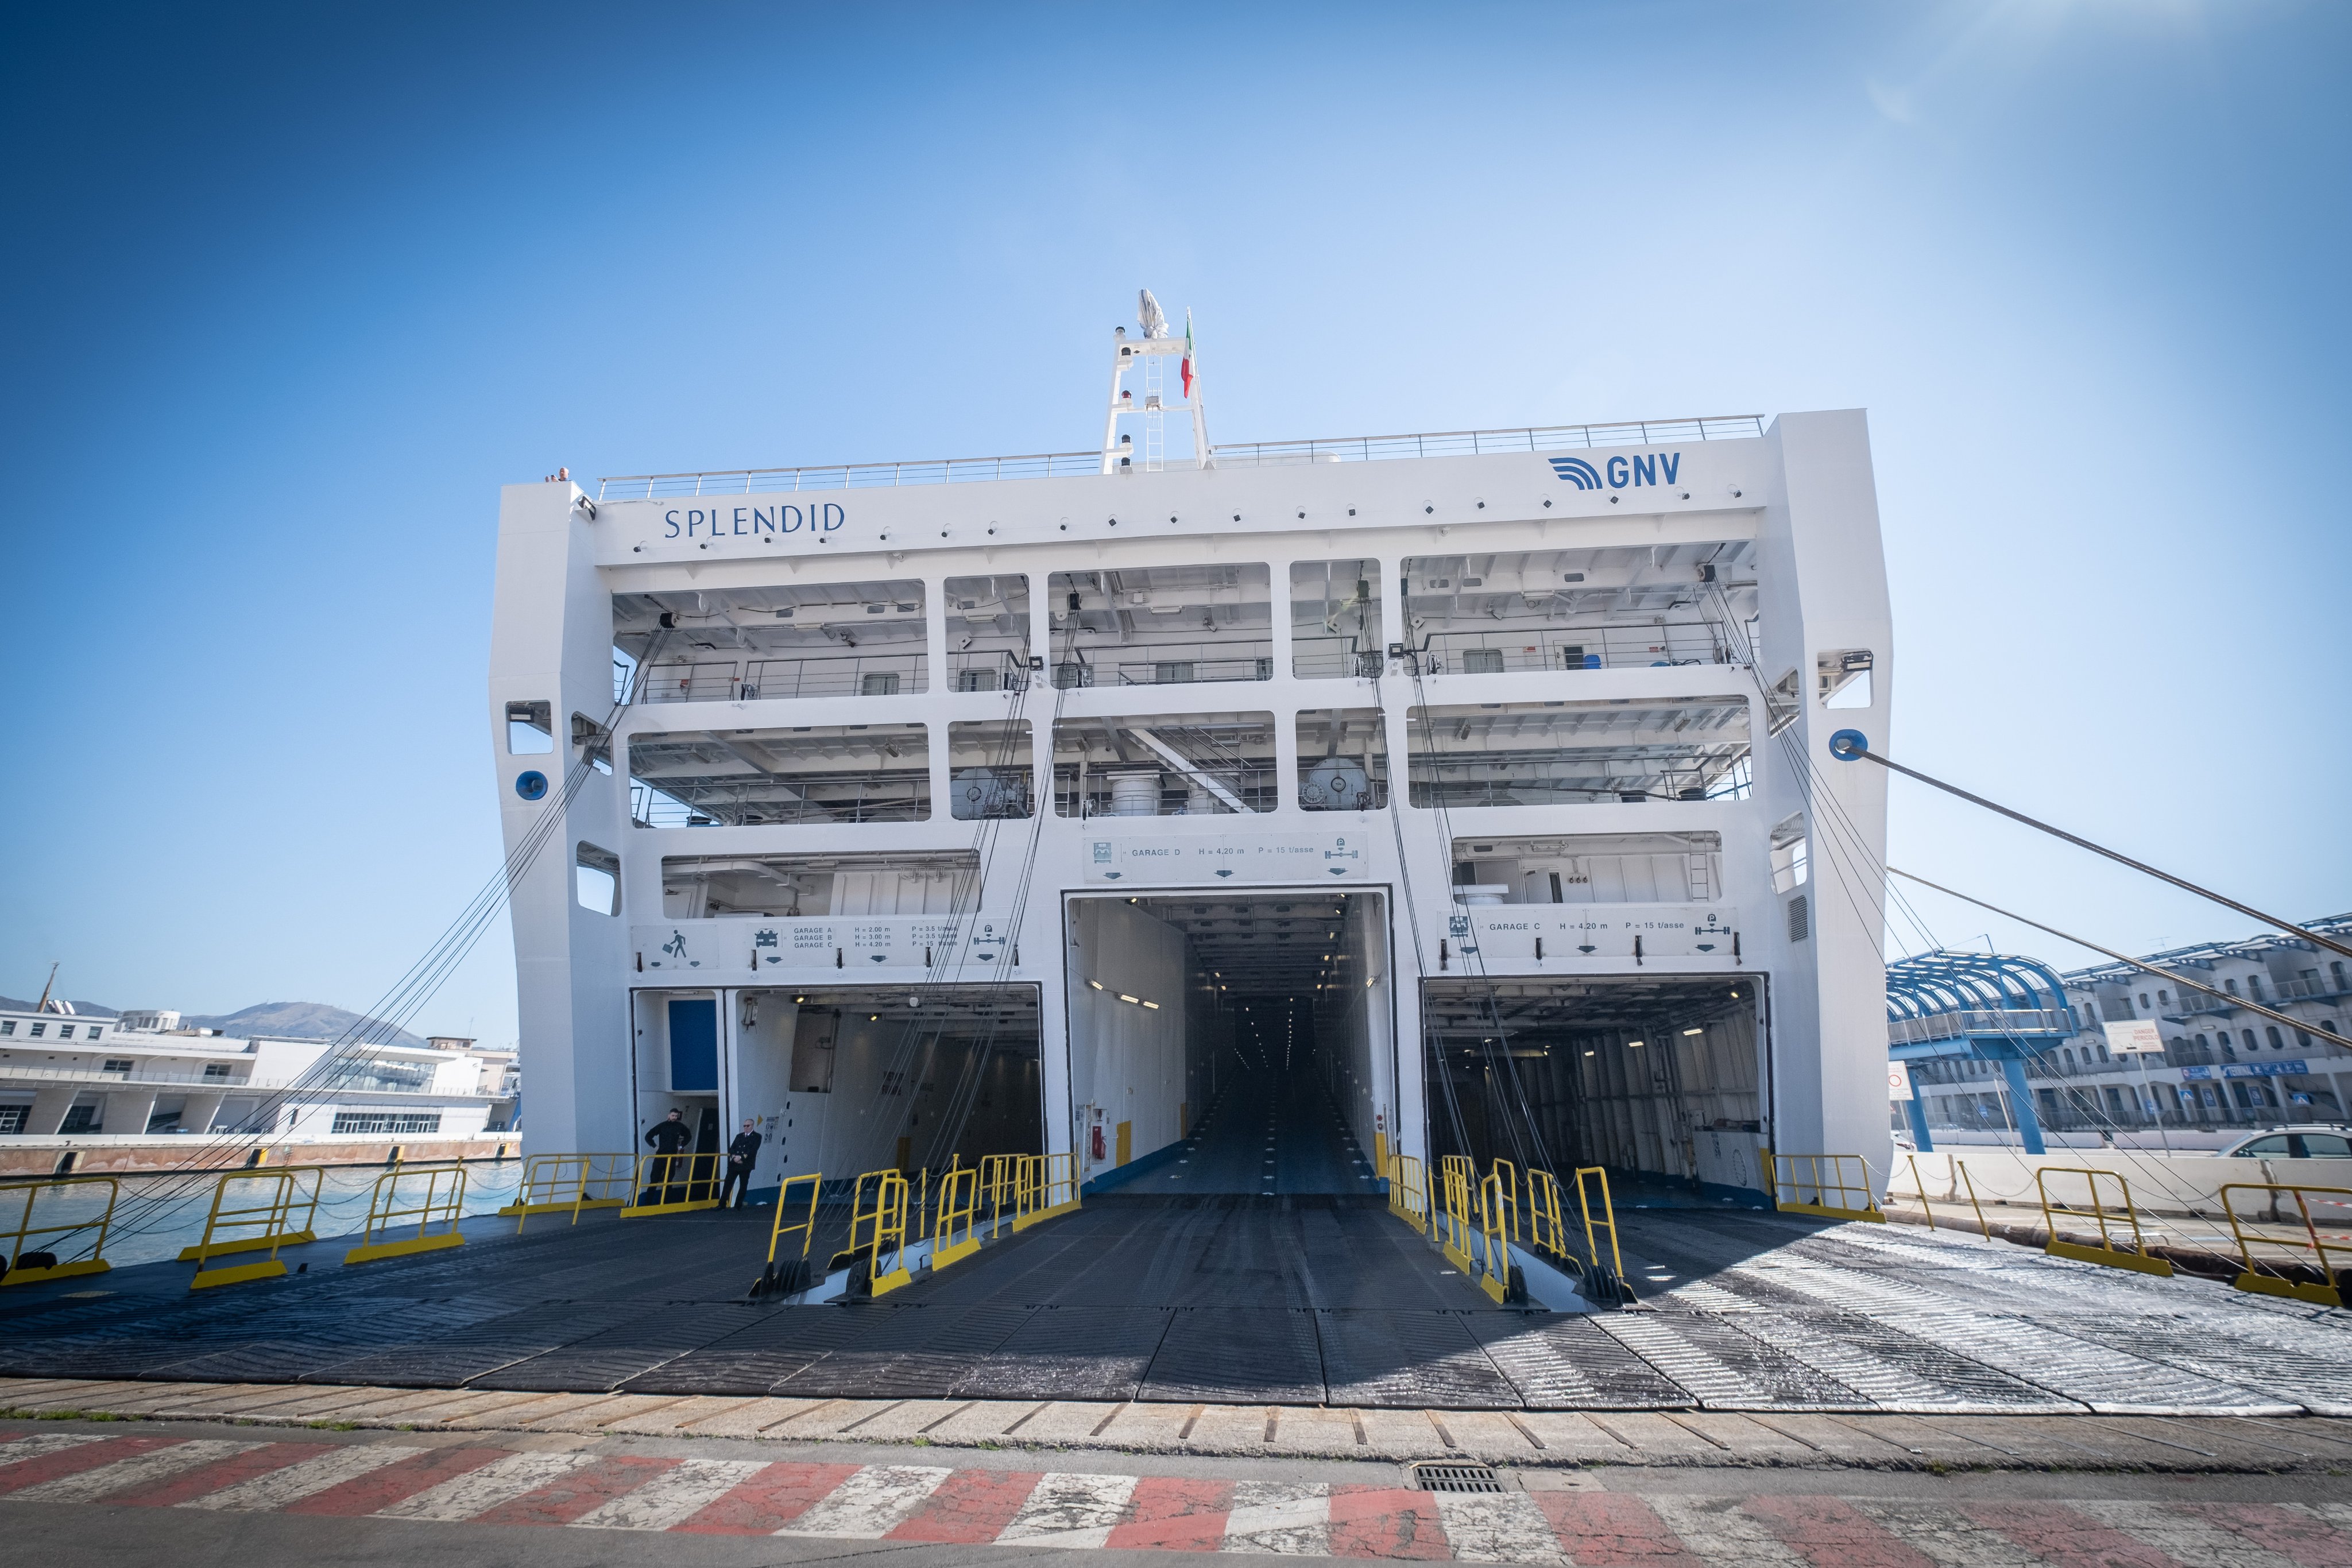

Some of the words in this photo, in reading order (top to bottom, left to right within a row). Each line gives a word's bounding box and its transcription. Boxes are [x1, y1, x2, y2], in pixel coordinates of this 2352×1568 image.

[1607, 452, 1680, 489] GNV
[665, 503, 845, 538] SPLENDID
[2229, 1065, 2254, 1077] TERMINAL
